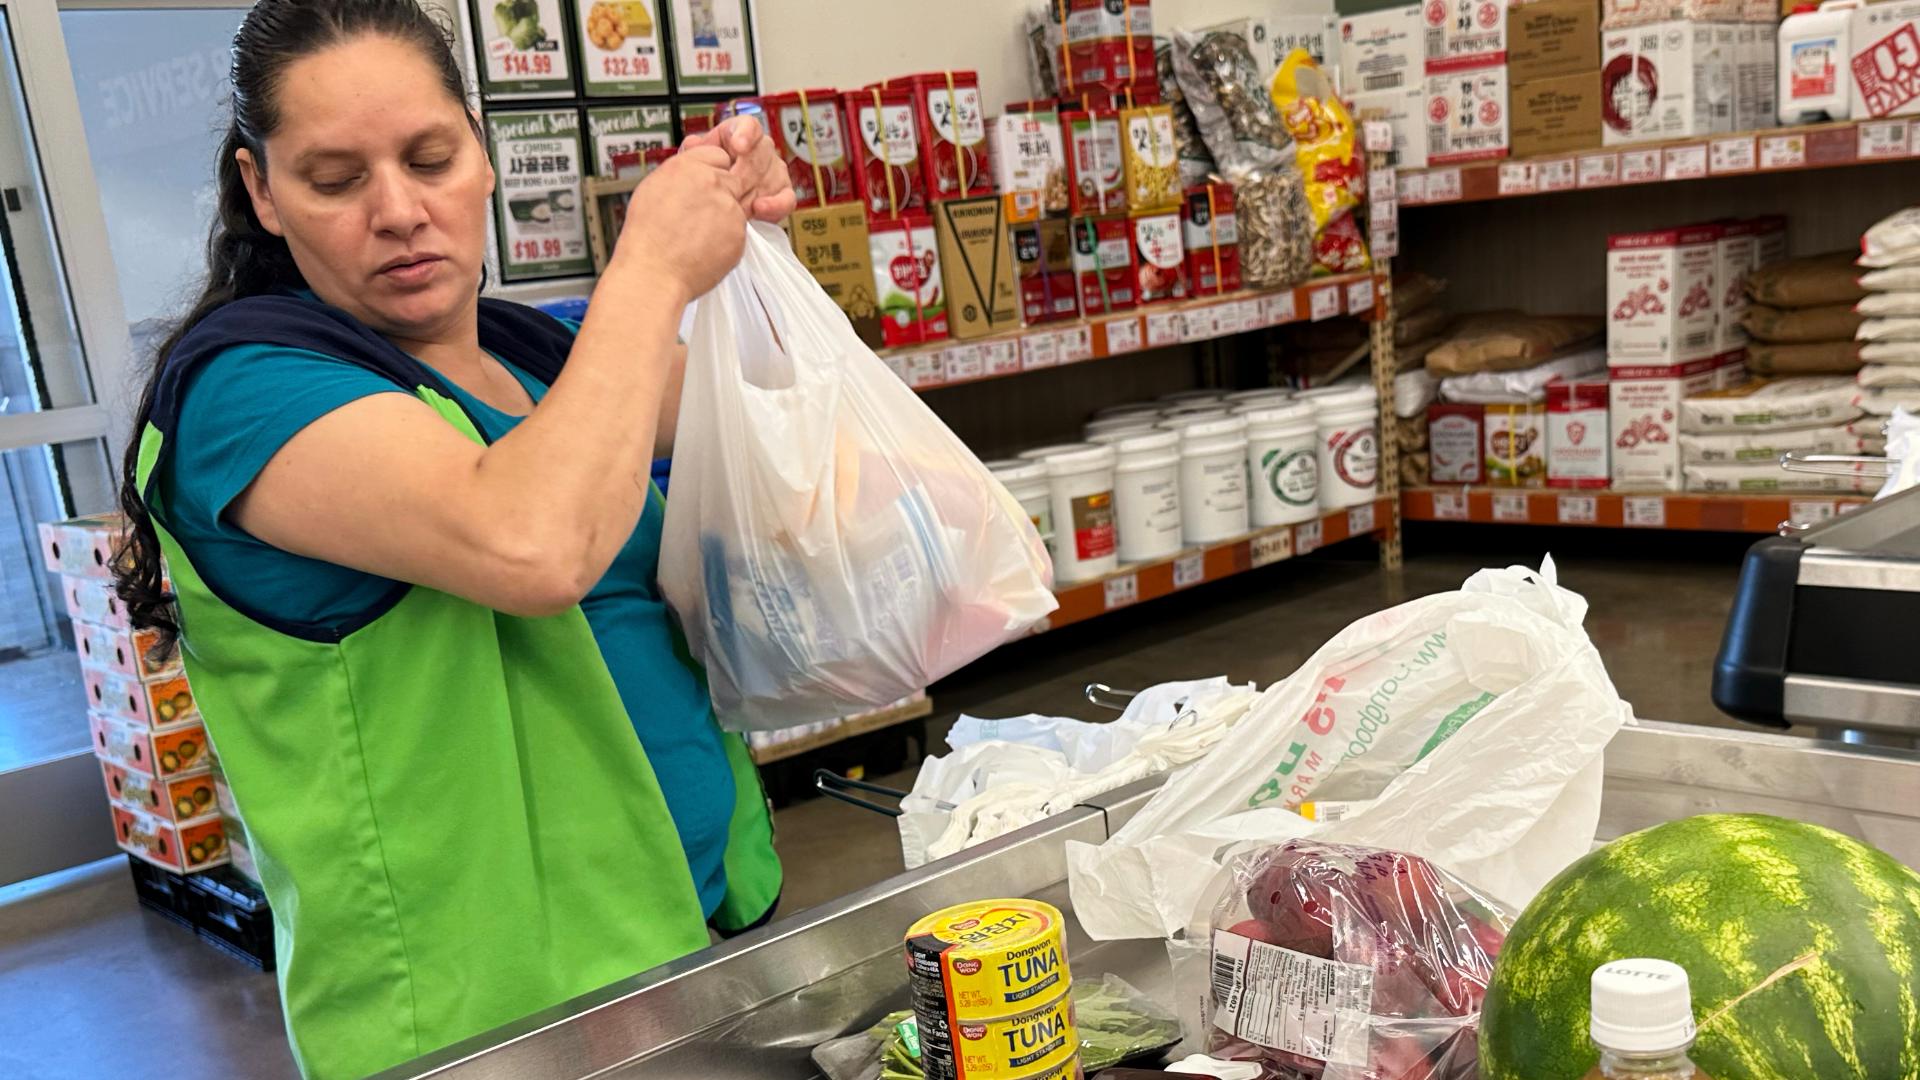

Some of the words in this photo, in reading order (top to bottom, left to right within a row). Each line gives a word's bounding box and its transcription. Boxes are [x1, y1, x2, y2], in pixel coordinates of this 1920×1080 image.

[503, 54, 552, 75] $14.99
[603, 56, 650, 76] $32.99
[695, 51, 732, 71] $7.99
[491, 116, 546, 141] Special
[547, 112, 579, 134] Sale
[588, 114, 639, 138] Special
[639, 108, 671, 130] Sale
[510, 156, 570, 174] 사골곰탕
[514, 239, 562, 259] $10.99
[1007, 939, 1051, 960] Dongwon
[956, 961, 979, 969] DONG
[998, 947, 1059, 987] TUNA
[1604, 967, 1672, 981] LOTTE
[1012, 988, 1030, 1001] LIGHT
[1031, 975, 1057, 994] STANDARD
[1234, 981, 1242, 994] ART.
[1228, 995, 1238, 1013] 6021
[1003, 1012, 1065, 1052] TUNA
[1016, 1056, 1034, 1066] LIGHT
